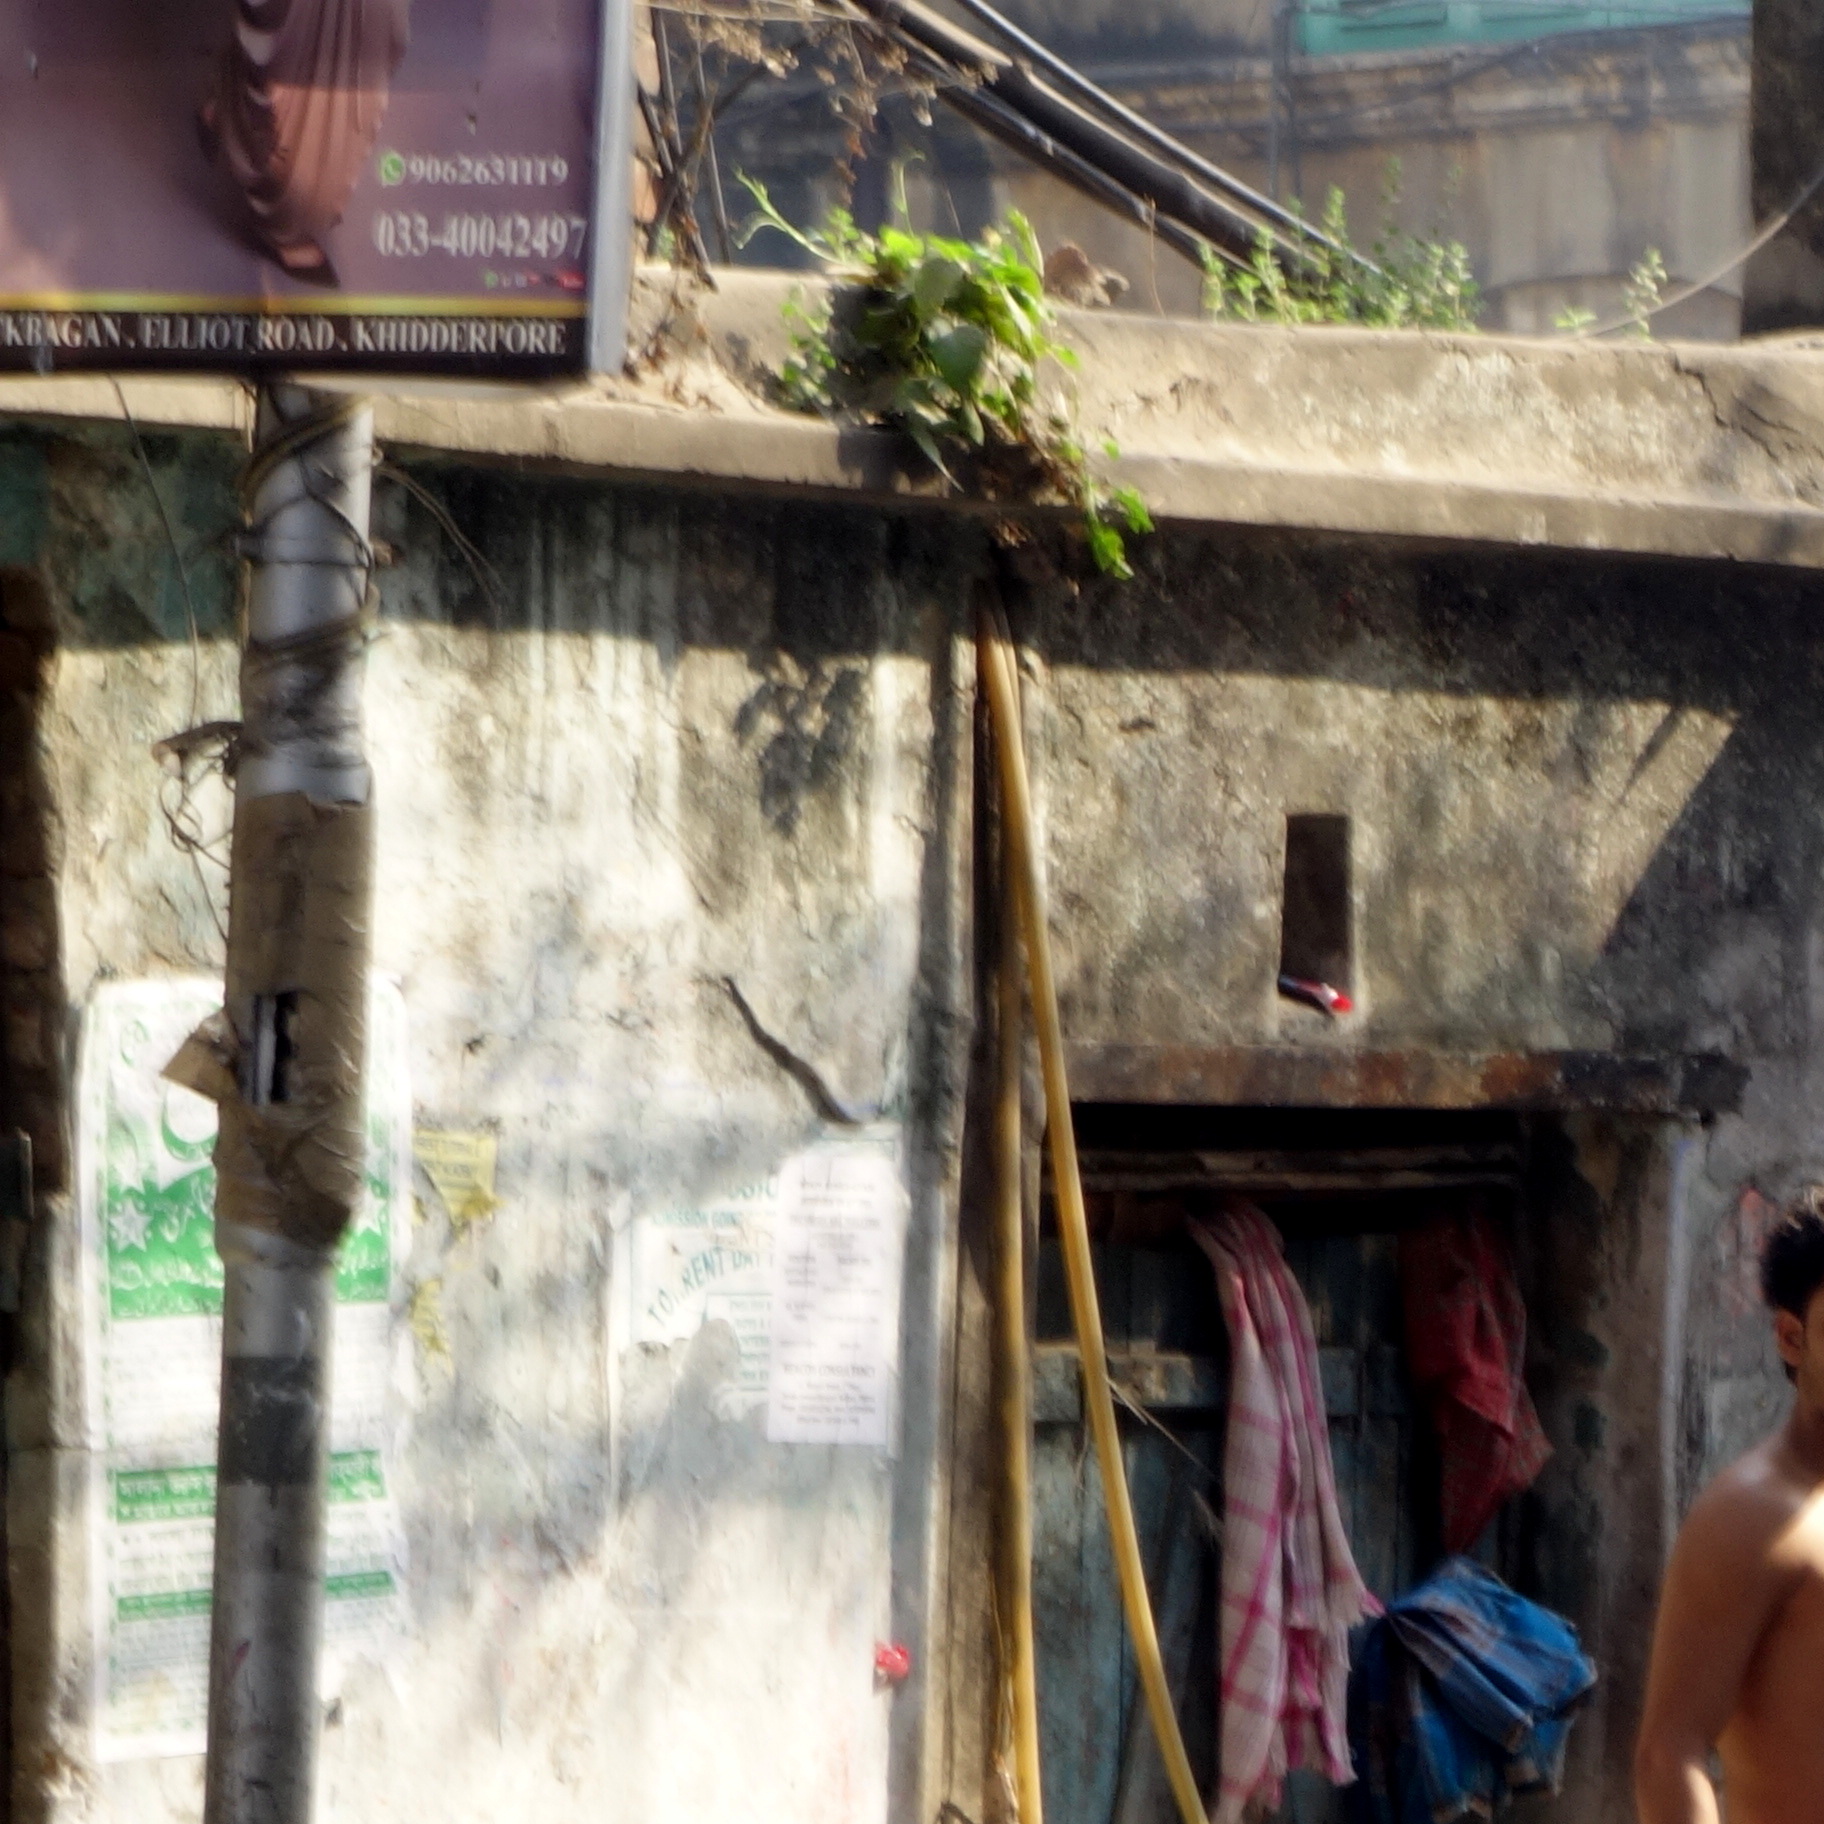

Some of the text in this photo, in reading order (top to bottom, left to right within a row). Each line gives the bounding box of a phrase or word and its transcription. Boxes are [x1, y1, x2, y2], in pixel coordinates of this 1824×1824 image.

[409, 156, 569, 185] 9062631119
[375, 211, 587, 258] 033-40042497
[354, 319, 567, 355] KHIDDERPORE
